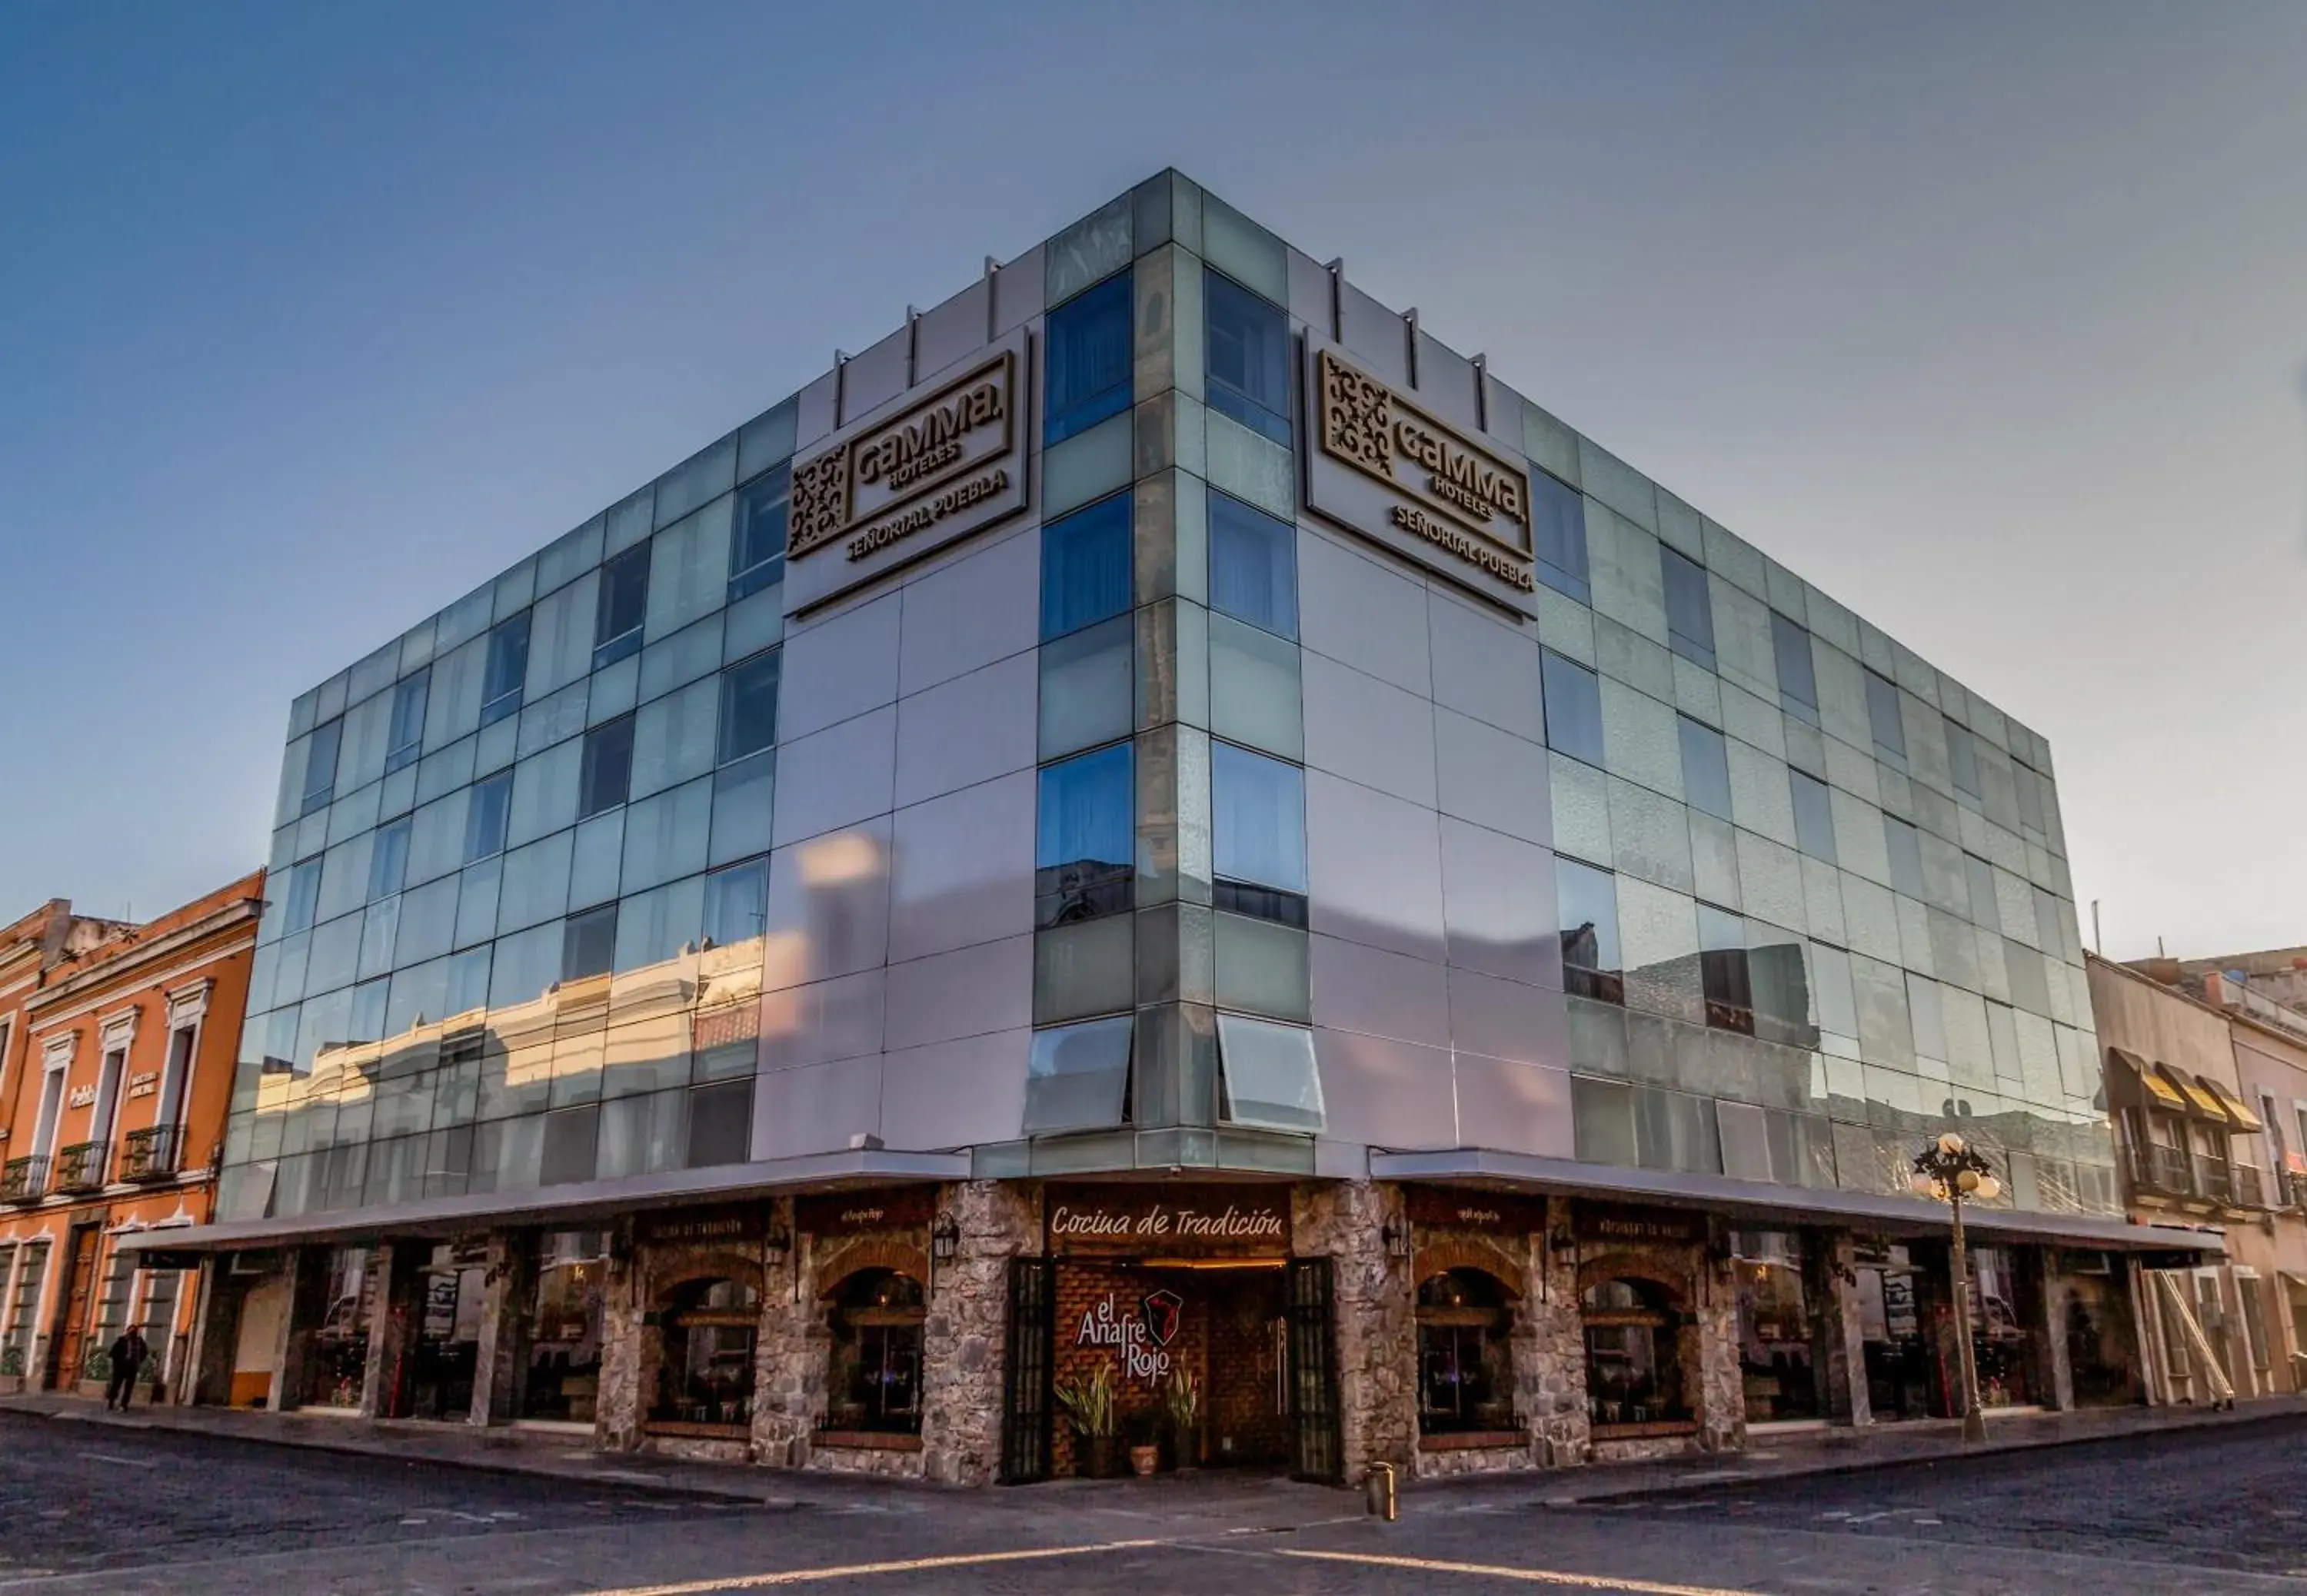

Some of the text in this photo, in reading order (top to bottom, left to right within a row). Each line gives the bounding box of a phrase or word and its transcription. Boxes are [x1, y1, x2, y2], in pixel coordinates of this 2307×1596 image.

[887, 441, 962, 490] HOTELES
[931, 468, 1010, 522] PUEBLA
[1434, 474, 1496, 522] HOTELES
[1395, 504, 1536, 592] SEÑORIAL PUEBLA
[1052, 1205, 1282, 1236] Cocina de Tradición
[1097, 1292, 1115, 1322] el
[1077, 1310, 1147, 1359] Anafre
[1127, 1343, 1170, 1389] Rojo
